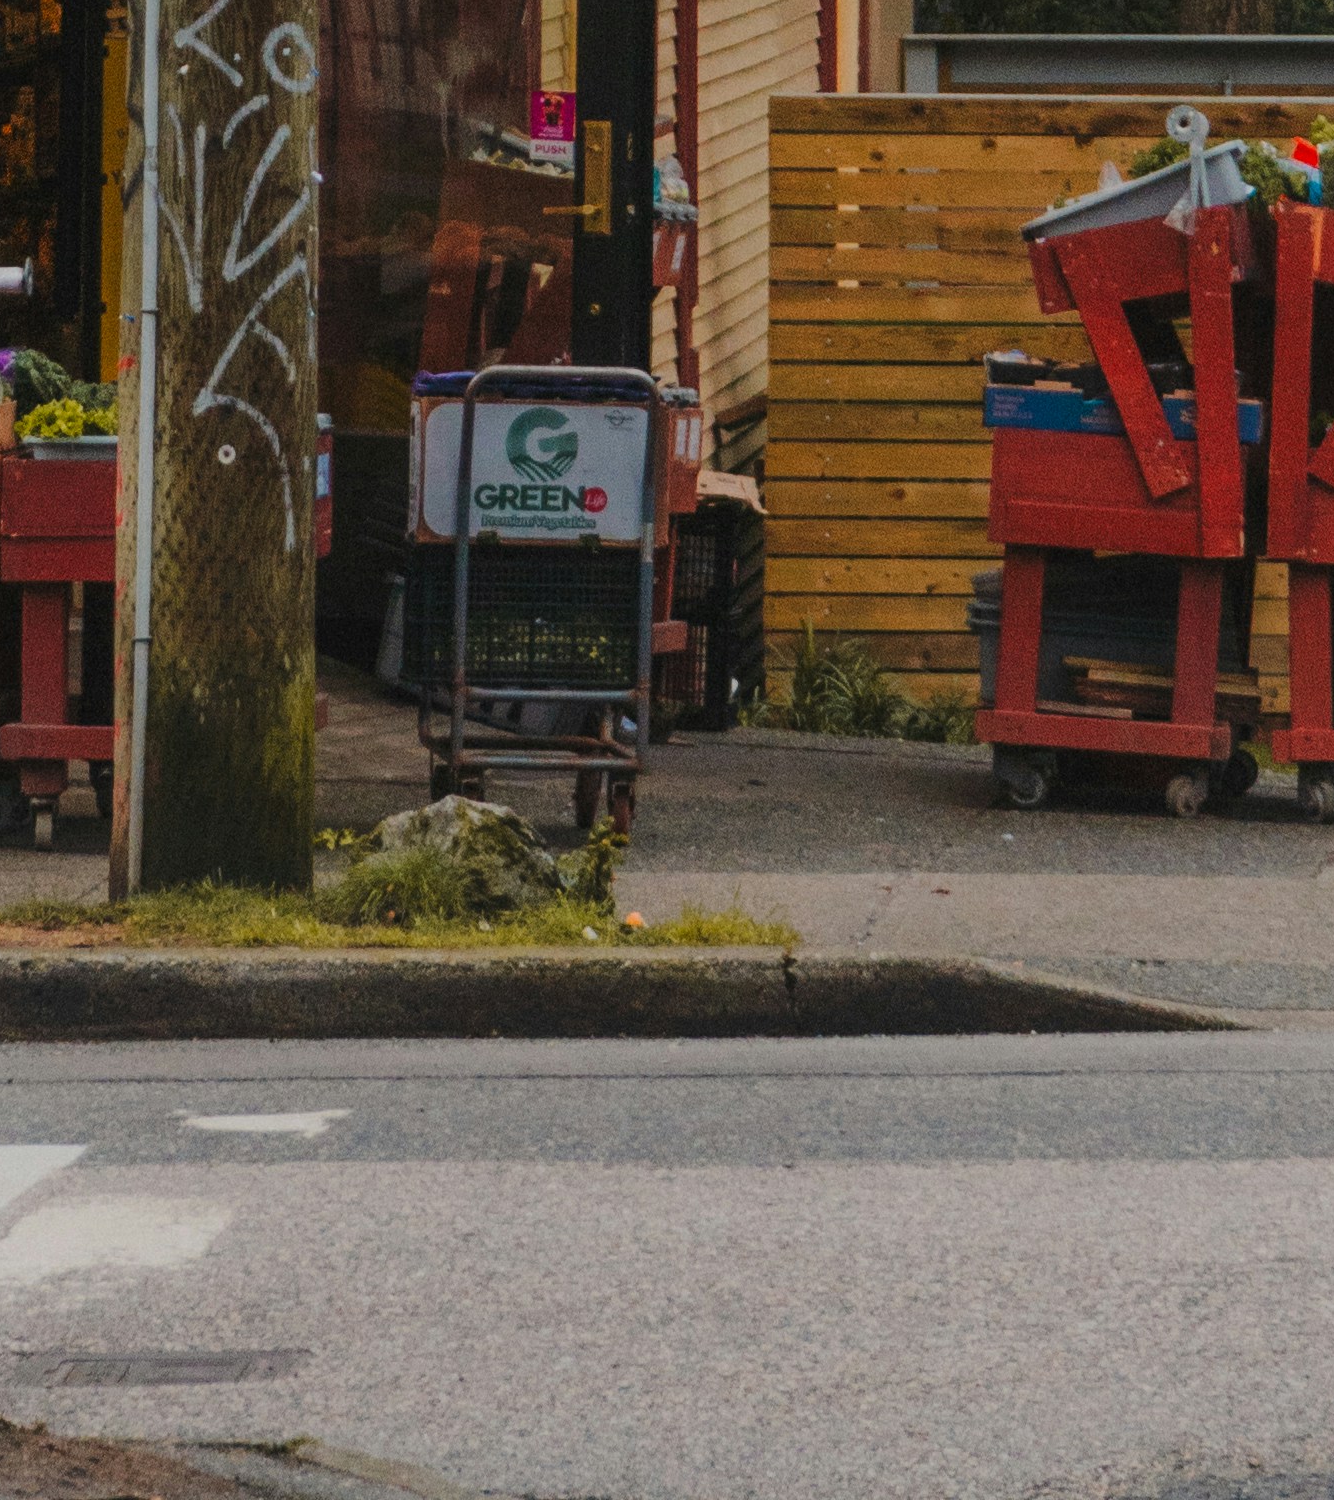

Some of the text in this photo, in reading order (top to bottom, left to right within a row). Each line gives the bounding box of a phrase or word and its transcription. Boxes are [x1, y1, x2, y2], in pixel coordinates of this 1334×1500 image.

[535, 144, 567, 155] PUSH
[474, 483, 586, 512] GREEN
[534, 515, 596, 531] Vegetables
